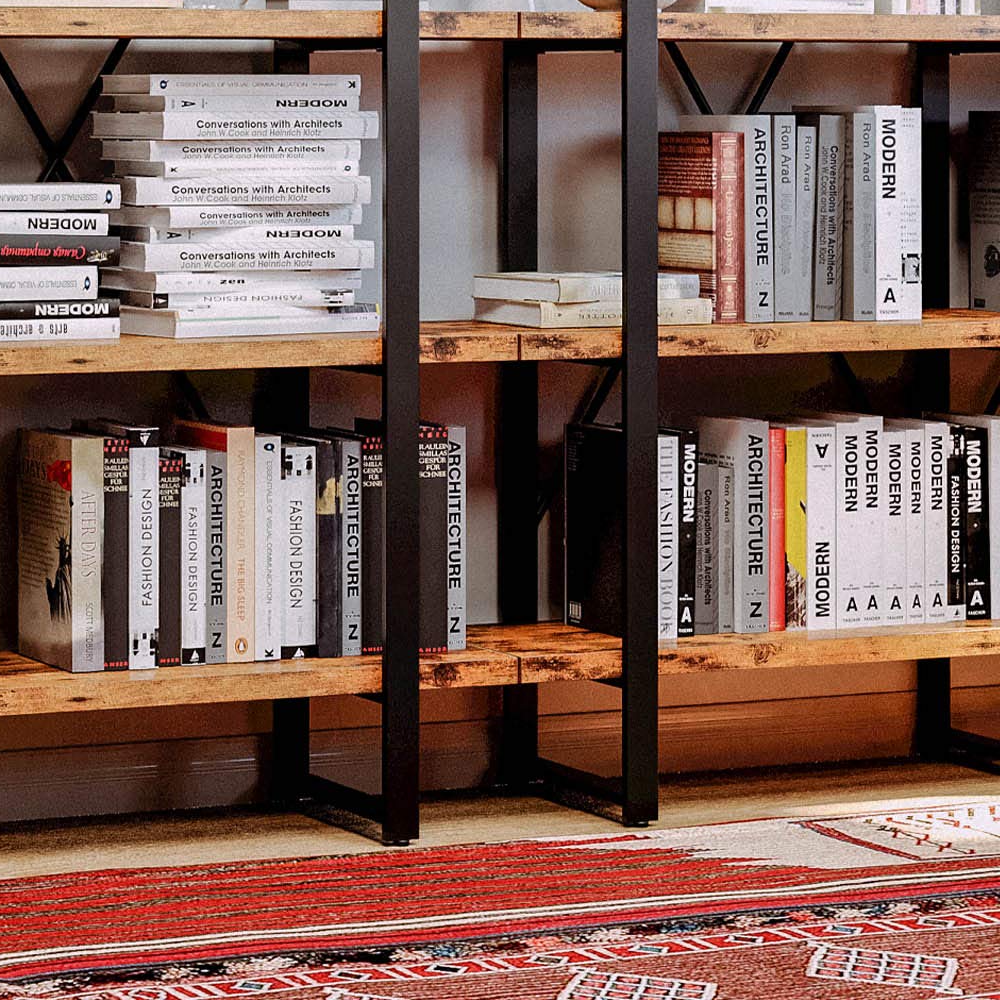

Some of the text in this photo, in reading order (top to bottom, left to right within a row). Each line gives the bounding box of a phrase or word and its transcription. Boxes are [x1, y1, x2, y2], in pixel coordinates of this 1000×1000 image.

[196, 119, 343, 130] Conversations with Architects
[275, 99, 348, 108] MODERN
[182, 145, 326, 154] Conversations with Architects
[780, 125, 791, 184] Ron Arad
[881, 119, 897, 199] MODERN
[27, 218, 97, 230] MODERN
[171, 184, 331, 194] Conversations with Architects
[753, 128, 769, 266] ARCHITECTURE
[179, 250, 336, 261] Conversations with Architects
[266, 230, 342, 238] MODERN
[35, 303, 110, 316] MODERN
[683, 444, 696, 523] MODERN
[748, 434, 763, 576] ARCHITECTURE
[845, 435, 858, 512] MODERN
[866, 430, 878, 509] MODERN
[888, 444, 901, 516] MODERN
[911, 441, 921, 514] MODERN
[931, 435, 943, 510] MODERN
[966, 440, 982, 514] MODERN
[81, 491, 97, 579] AFTER DAYS
[142, 489, 152, 606] FASHION DESIGN
[210, 465, 223, 606] ARCHITECTURE
[346, 454, 359, 598] ARCHITECTURE
[448, 441, 462, 589] ARCHITECTURE
[951, 475, 960, 574] FASHION DESIGN
[188, 507, 197, 612] FASHION DESIGN
[289, 500, 303, 609] FASHION DESIGN
[815, 541, 830, 618] MODERN
